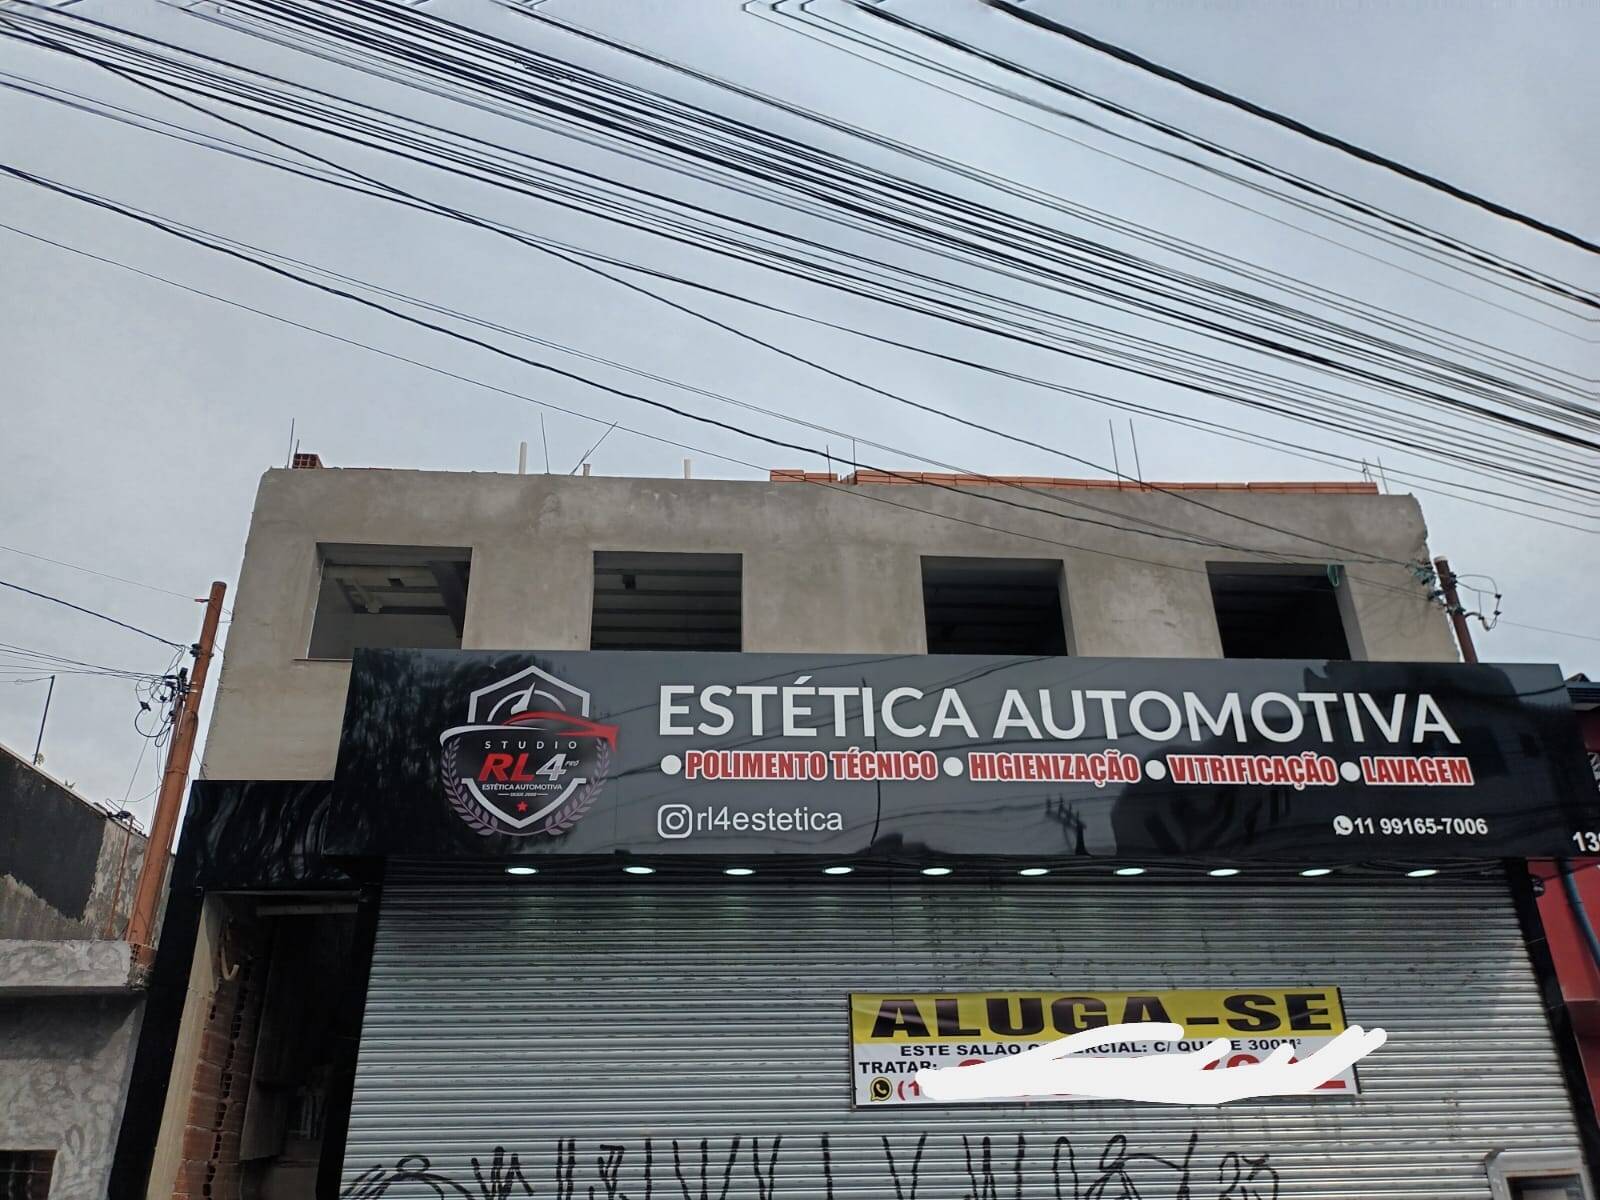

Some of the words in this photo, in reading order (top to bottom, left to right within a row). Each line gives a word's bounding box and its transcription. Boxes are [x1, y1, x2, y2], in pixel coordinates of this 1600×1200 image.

[659, 675, 979, 738] ESTÉTICA
[993, 687, 1461, 744] AUTOMOTIVA
[484, 740, 577, 749] STUDIO
[685, 750, 827, 780] POLIMENTO
[830, 746, 938, 781] TÉCNICO
[968, 749, 1142, 787] HIGIENIZAÇÃO
[1167, 751, 1338, 790] VITRIFICAÇÃO
[1359, 756, 1475, 786] LAVAGEM
[697, 806, 843, 832] rl4estetica
[1354, 817, 1375, 834] 11
[1379, 817, 1489, 835] 99165-7006
[1572, 831, 1600, 852] 13
[870, 994, 1331, 1037] ALUGA-SE
[901, 1045, 950, 1057] ESTE
[956, 1042, 1021, 1056] SALÃO
[1154, 1040, 1171, 1053] C/
[1177, 1038, 1243, 1053] QUE
